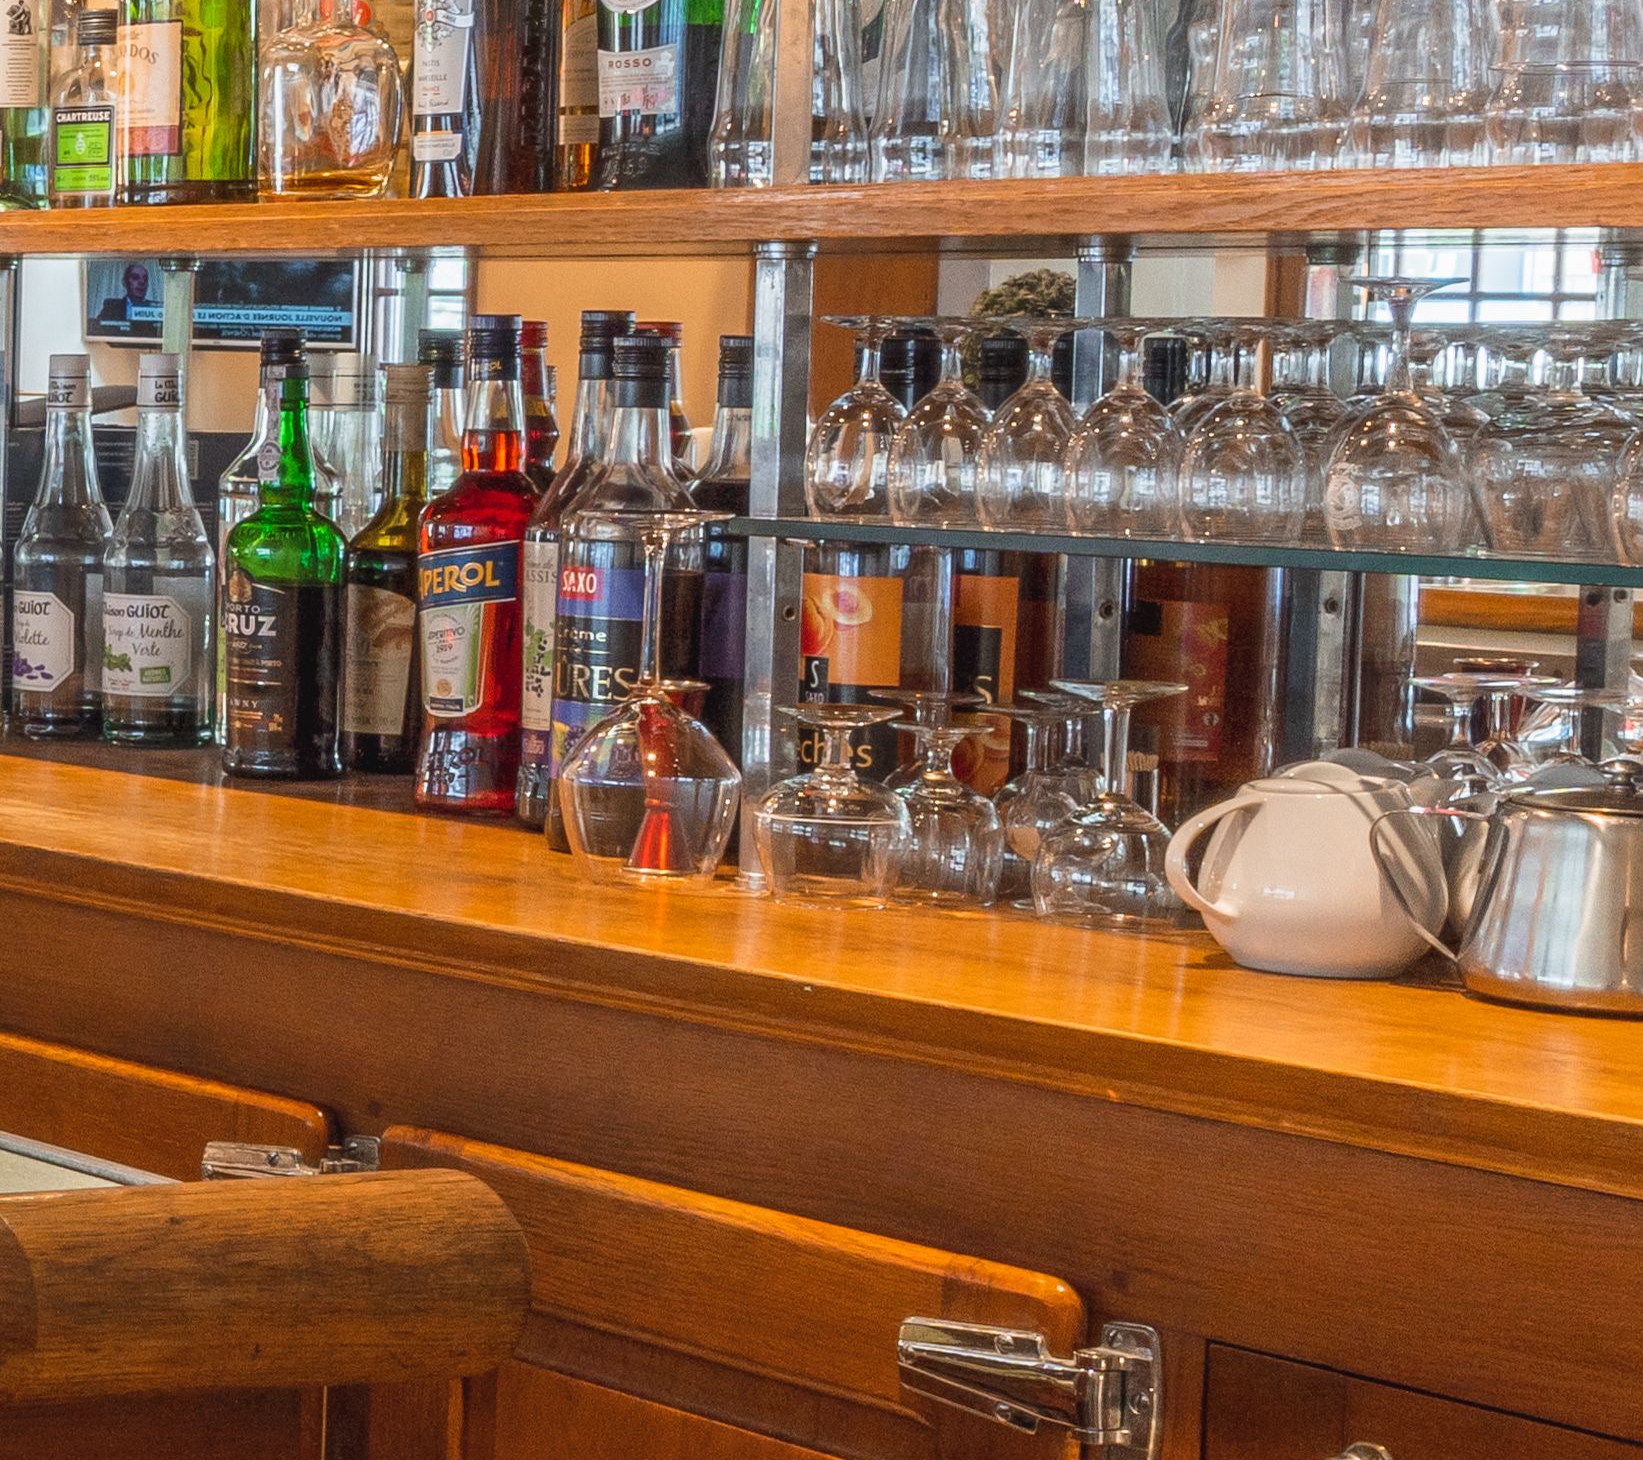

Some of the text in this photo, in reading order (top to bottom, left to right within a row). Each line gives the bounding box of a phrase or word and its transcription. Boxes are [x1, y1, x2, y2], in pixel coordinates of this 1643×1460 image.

[608, 58, 652, 68] ROSSO
[56, 112, 110, 122] CHARTREUSE
[562, 570, 597, 593] SAXO
[139, 619, 184, 639] Menthe
[131, 642, 162, 657] Verte
[557, 653, 634, 702] ÛRES
